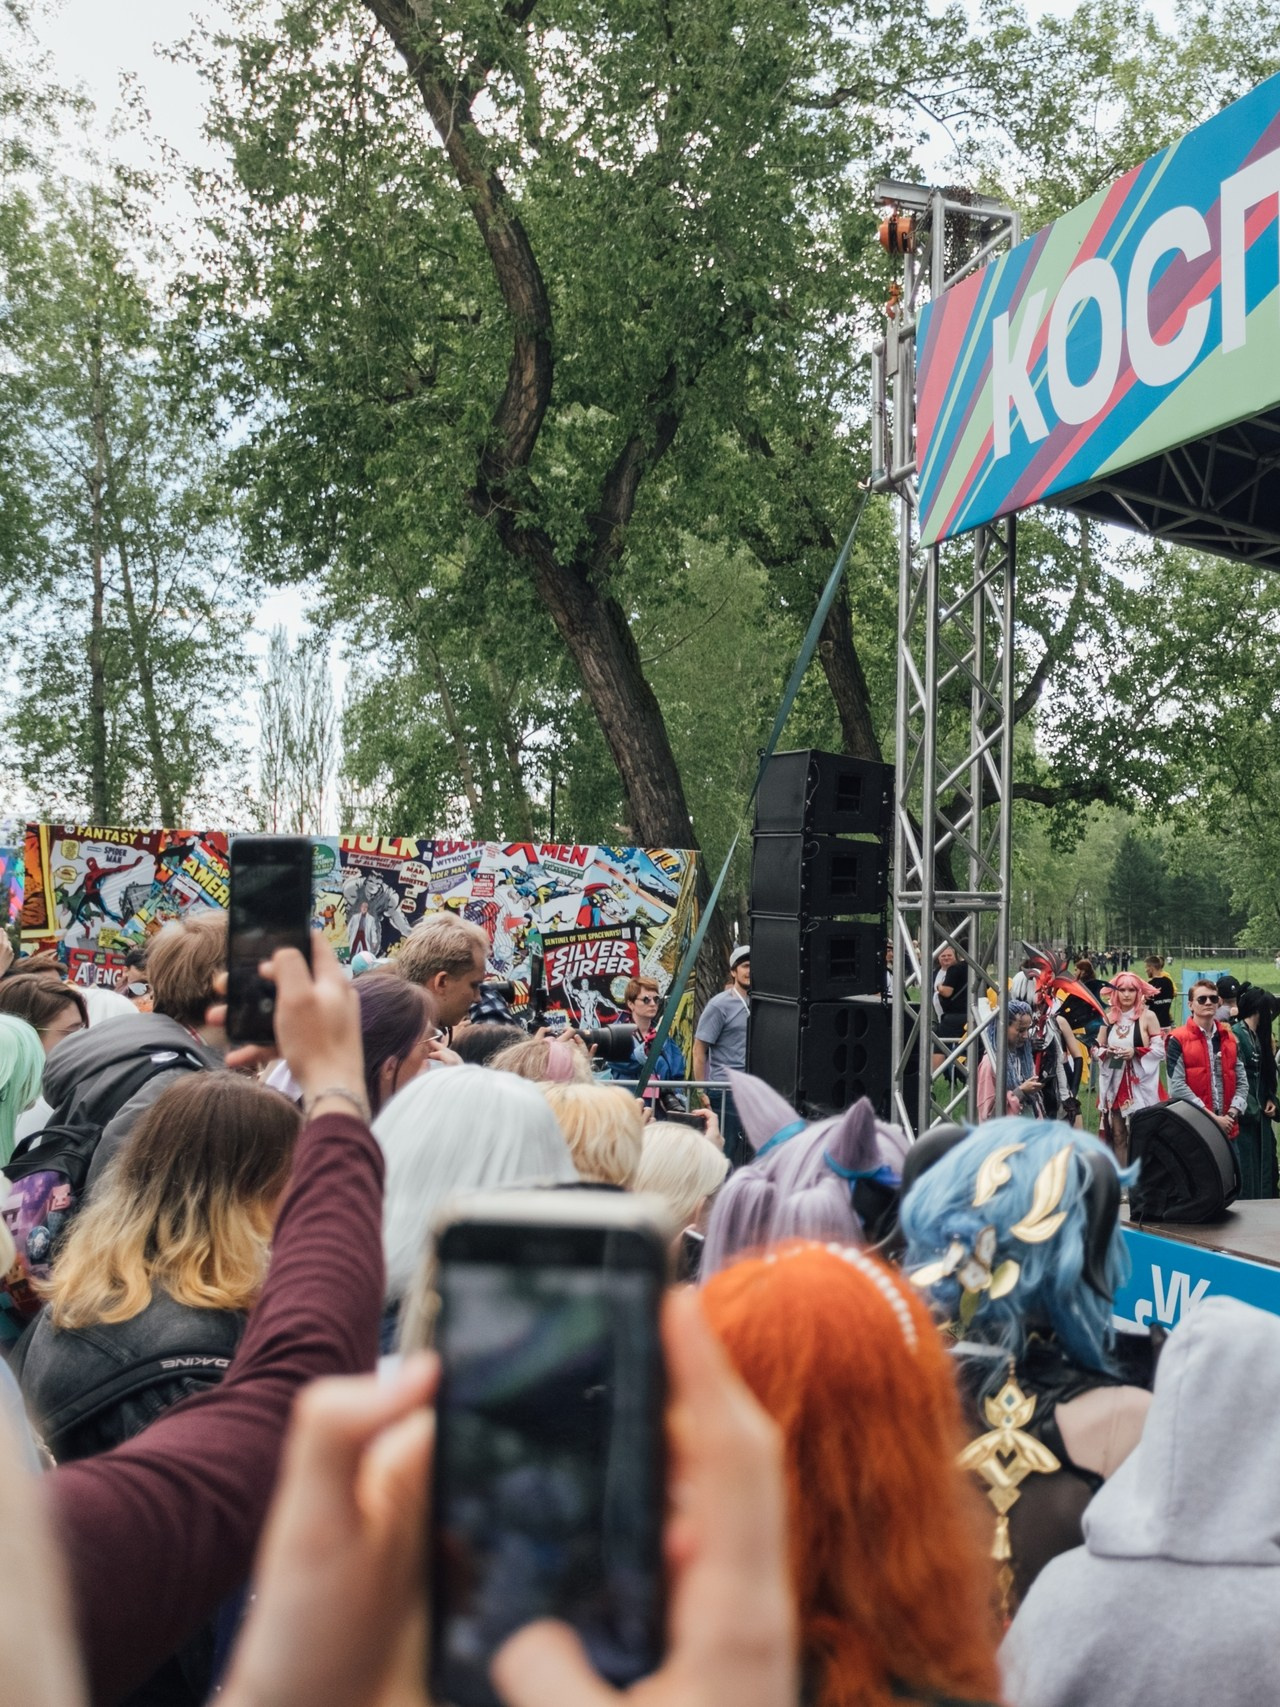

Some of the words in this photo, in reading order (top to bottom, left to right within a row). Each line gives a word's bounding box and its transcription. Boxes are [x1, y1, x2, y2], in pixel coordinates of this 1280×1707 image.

[76, 826, 138, 845] FANTASY
[104, 846, 128, 857] SPIDER
[339, 835, 420, 859] HULK
[106, 855, 122, 864] MAN
[436, 852, 471, 867] WITHOUT
[406, 866, 425, 875] MAN
[431, 869, 449, 881] NDER
[181, 858, 231, 910] AMERI
[544, 936, 569, 946] SENTINEL
[569, 935, 577, 943] OF
[577, 933, 588, 942] THE
[588, 929, 622, 941] SPACEWAYS!
[554, 940, 631, 968] SILVER
[550, 957, 635, 987] SURFER
[161, 1357, 231, 1369] DAKINE
